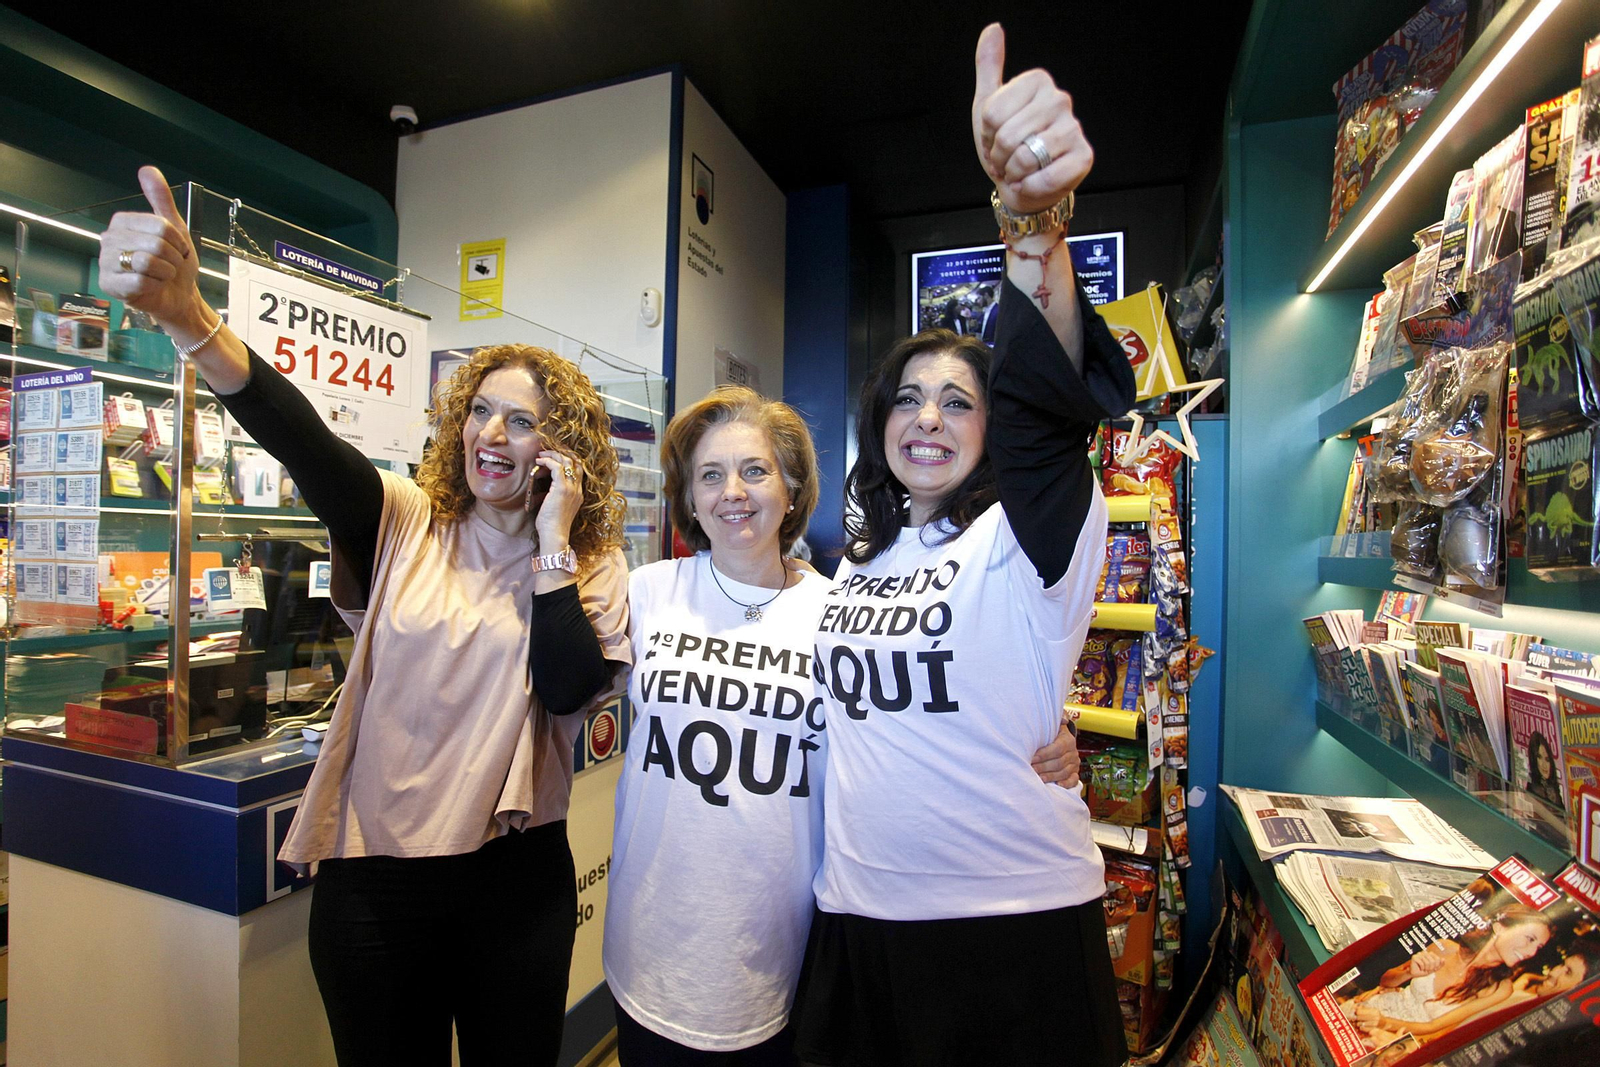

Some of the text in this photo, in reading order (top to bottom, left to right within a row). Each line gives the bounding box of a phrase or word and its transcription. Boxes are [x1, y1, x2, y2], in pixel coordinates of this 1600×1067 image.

[282, 248, 379, 290] LOTERÍA DE NAVIDAD
[940, 269, 965, 277] SORTEO
[977, 266, 1005, 274] NAVIDA
[966, 257, 1001, 265] DICIEMBRE
[62, 301, 108, 316] Energizer
[288, 300, 407, 358] PREMIO
[21, 376, 49, 388] LOTERÍA
[51, 376, 64, 385] DEL
[66, 371, 84, 382] NIÑO
[274, 336, 396, 397] 51244
[1527, 430, 1591, 472] SPINOSAURO
[819, 601, 953, 637] ENDIDO
[640, 670, 827, 732] VENDIDO
[643, 715, 821, 807] AQUÍ
[1498, 859, 1554, 906] ¡HOLA!
[1436, 906, 1467, 935] ENAMORADOS
[1443, 901, 1469, 926] DIVERTIDOS
[1450, 894, 1488, 930] FERNANDO
[1434, 925, 1450, 940] BODA
[1440, 921, 1459, 938] FIESTA
[1320, 998, 1337, 1021] EMOCIÓN
